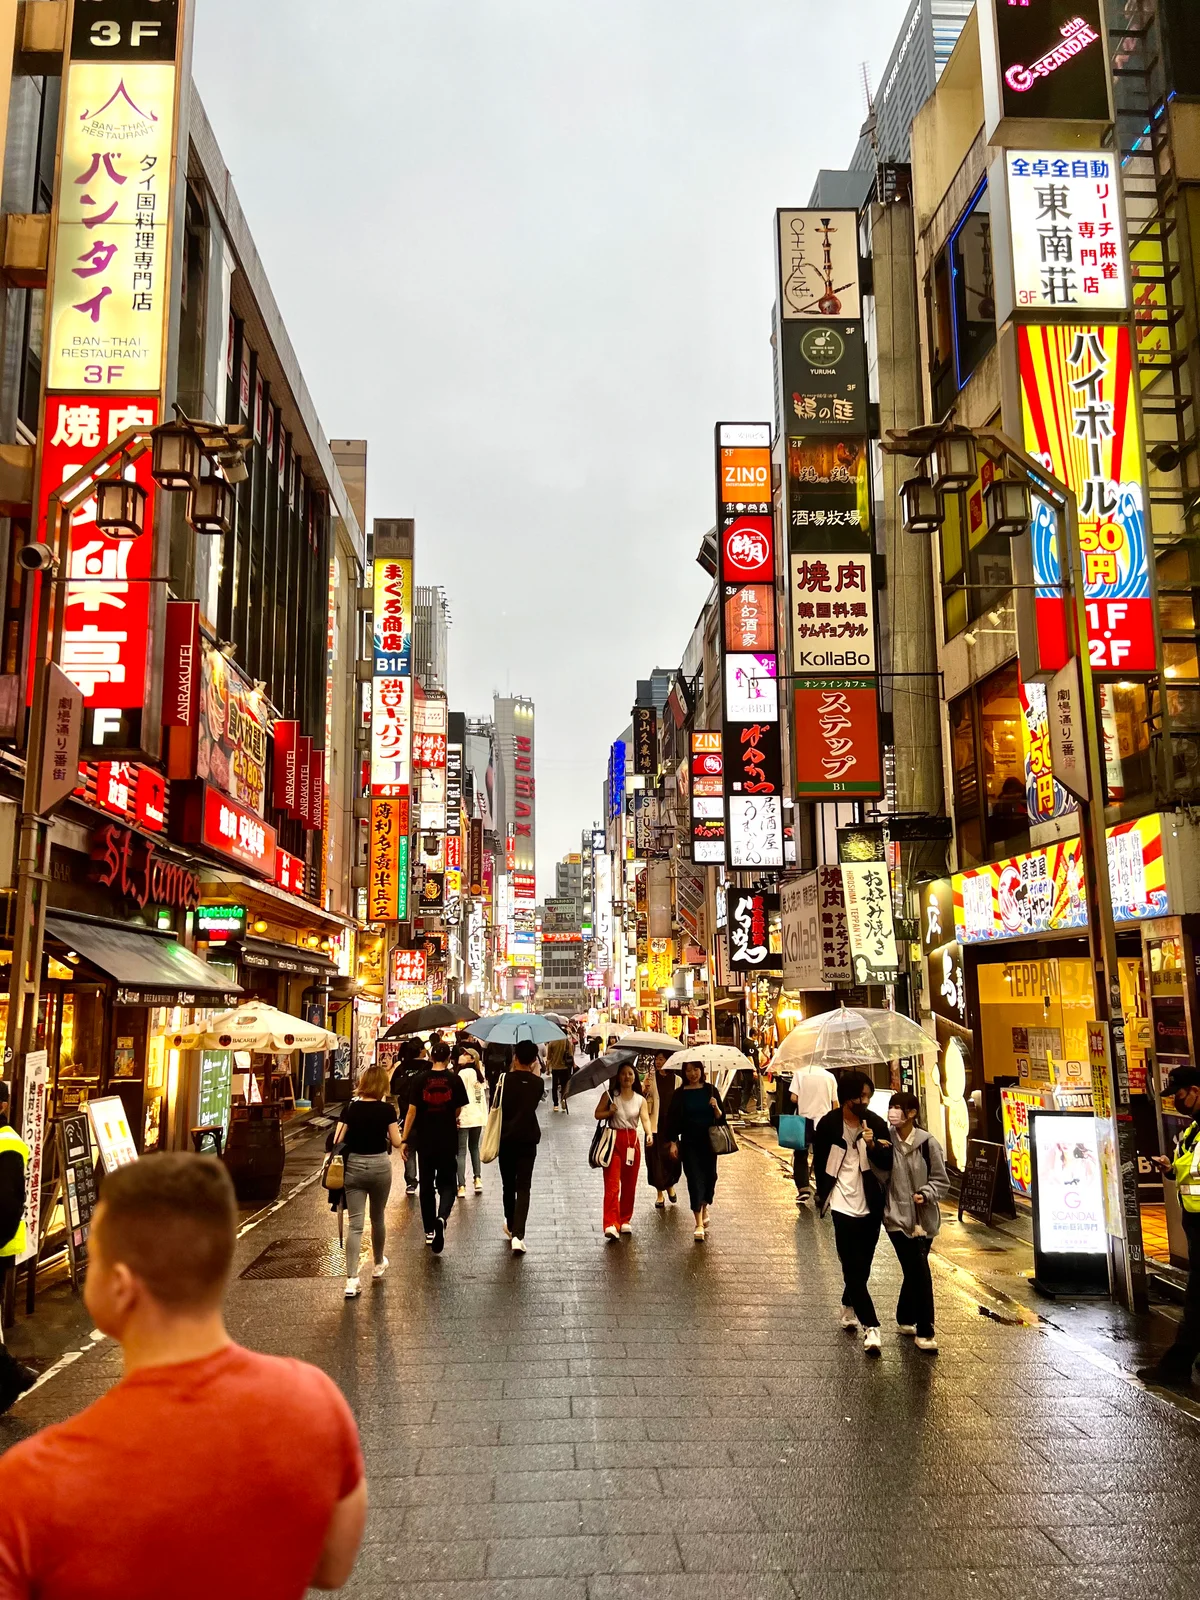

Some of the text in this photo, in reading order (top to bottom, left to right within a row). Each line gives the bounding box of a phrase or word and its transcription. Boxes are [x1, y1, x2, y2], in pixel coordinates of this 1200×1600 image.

[89, 20, 162, 47] 3F
[1060, 16, 1085, 38] CLUB
[81, 124, 155, 140] RESTAURANT
[91, 119, 147, 132] BAN-THAI
[1010, 158, 1110, 179] 全卓全自動
[72, 151, 129, 323] バンタイ
[131, 153, 158, 311] タイ国料理専門店
[1033, 182, 1079, 306] 東南荘
[1096, 183, 1119, 280] リーチ麻雀
[1078, 221, 1100, 294] 専門店
[1018, 290, 1037, 305] 3F
[61, 348, 149, 359] RESTAURANT
[72, 336, 142, 346] BAN-THAI
[83, 365, 125, 384] 3F
[1067, 333, 1119, 517] ハイボール
[725, 466, 767, 482] ZINO
[724, 517, 734, 526] 4F
[792, 509, 863, 526] 酒場牧場
[796, 560, 867, 593] 焼肉
[1086, 553, 1117, 585] 円
[382, 564, 403, 651] まぐろ商店
[797, 602, 868, 619] 韓国料理
[1084, 603, 1129, 630] 1F
[797, 623, 869, 639] サムギョプサル
[376, 658, 408, 672] B1F
[800, 650, 871, 667] KollaBo
[1087, 640, 1132, 667] 2F
[176, 644, 192, 726] ANRAKUTEI
[803, 680, 868, 688] オンラインカフェ
[52, 697, 73, 781] 劇場通り一番街
[817, 691, 857, 780] ステップ
[285, 750, 295, 809] ANRAKUTEI
[300, 764, 310, 819] ANRAKUTEI
[380, 785, 400, 796] 4F
[833, 783, 846, 791] B1
[312, 776, 322, 829] ANRAKUTEI
[760, 797, 778, 850] 居酒屋
[137, 840, 201, 912] James
[820, 867, 846, 909] 焼肉
[845, 870, 863, 949] HIROSHIMA TEPPANYAKI
[861, 869, 893, 956] お好み焼き
[876, 971, 898, 982] B1F
[1006, 960, 1059, 997] TEPPAN
[1052, 1211, 1097, 1222] SCANDAL
